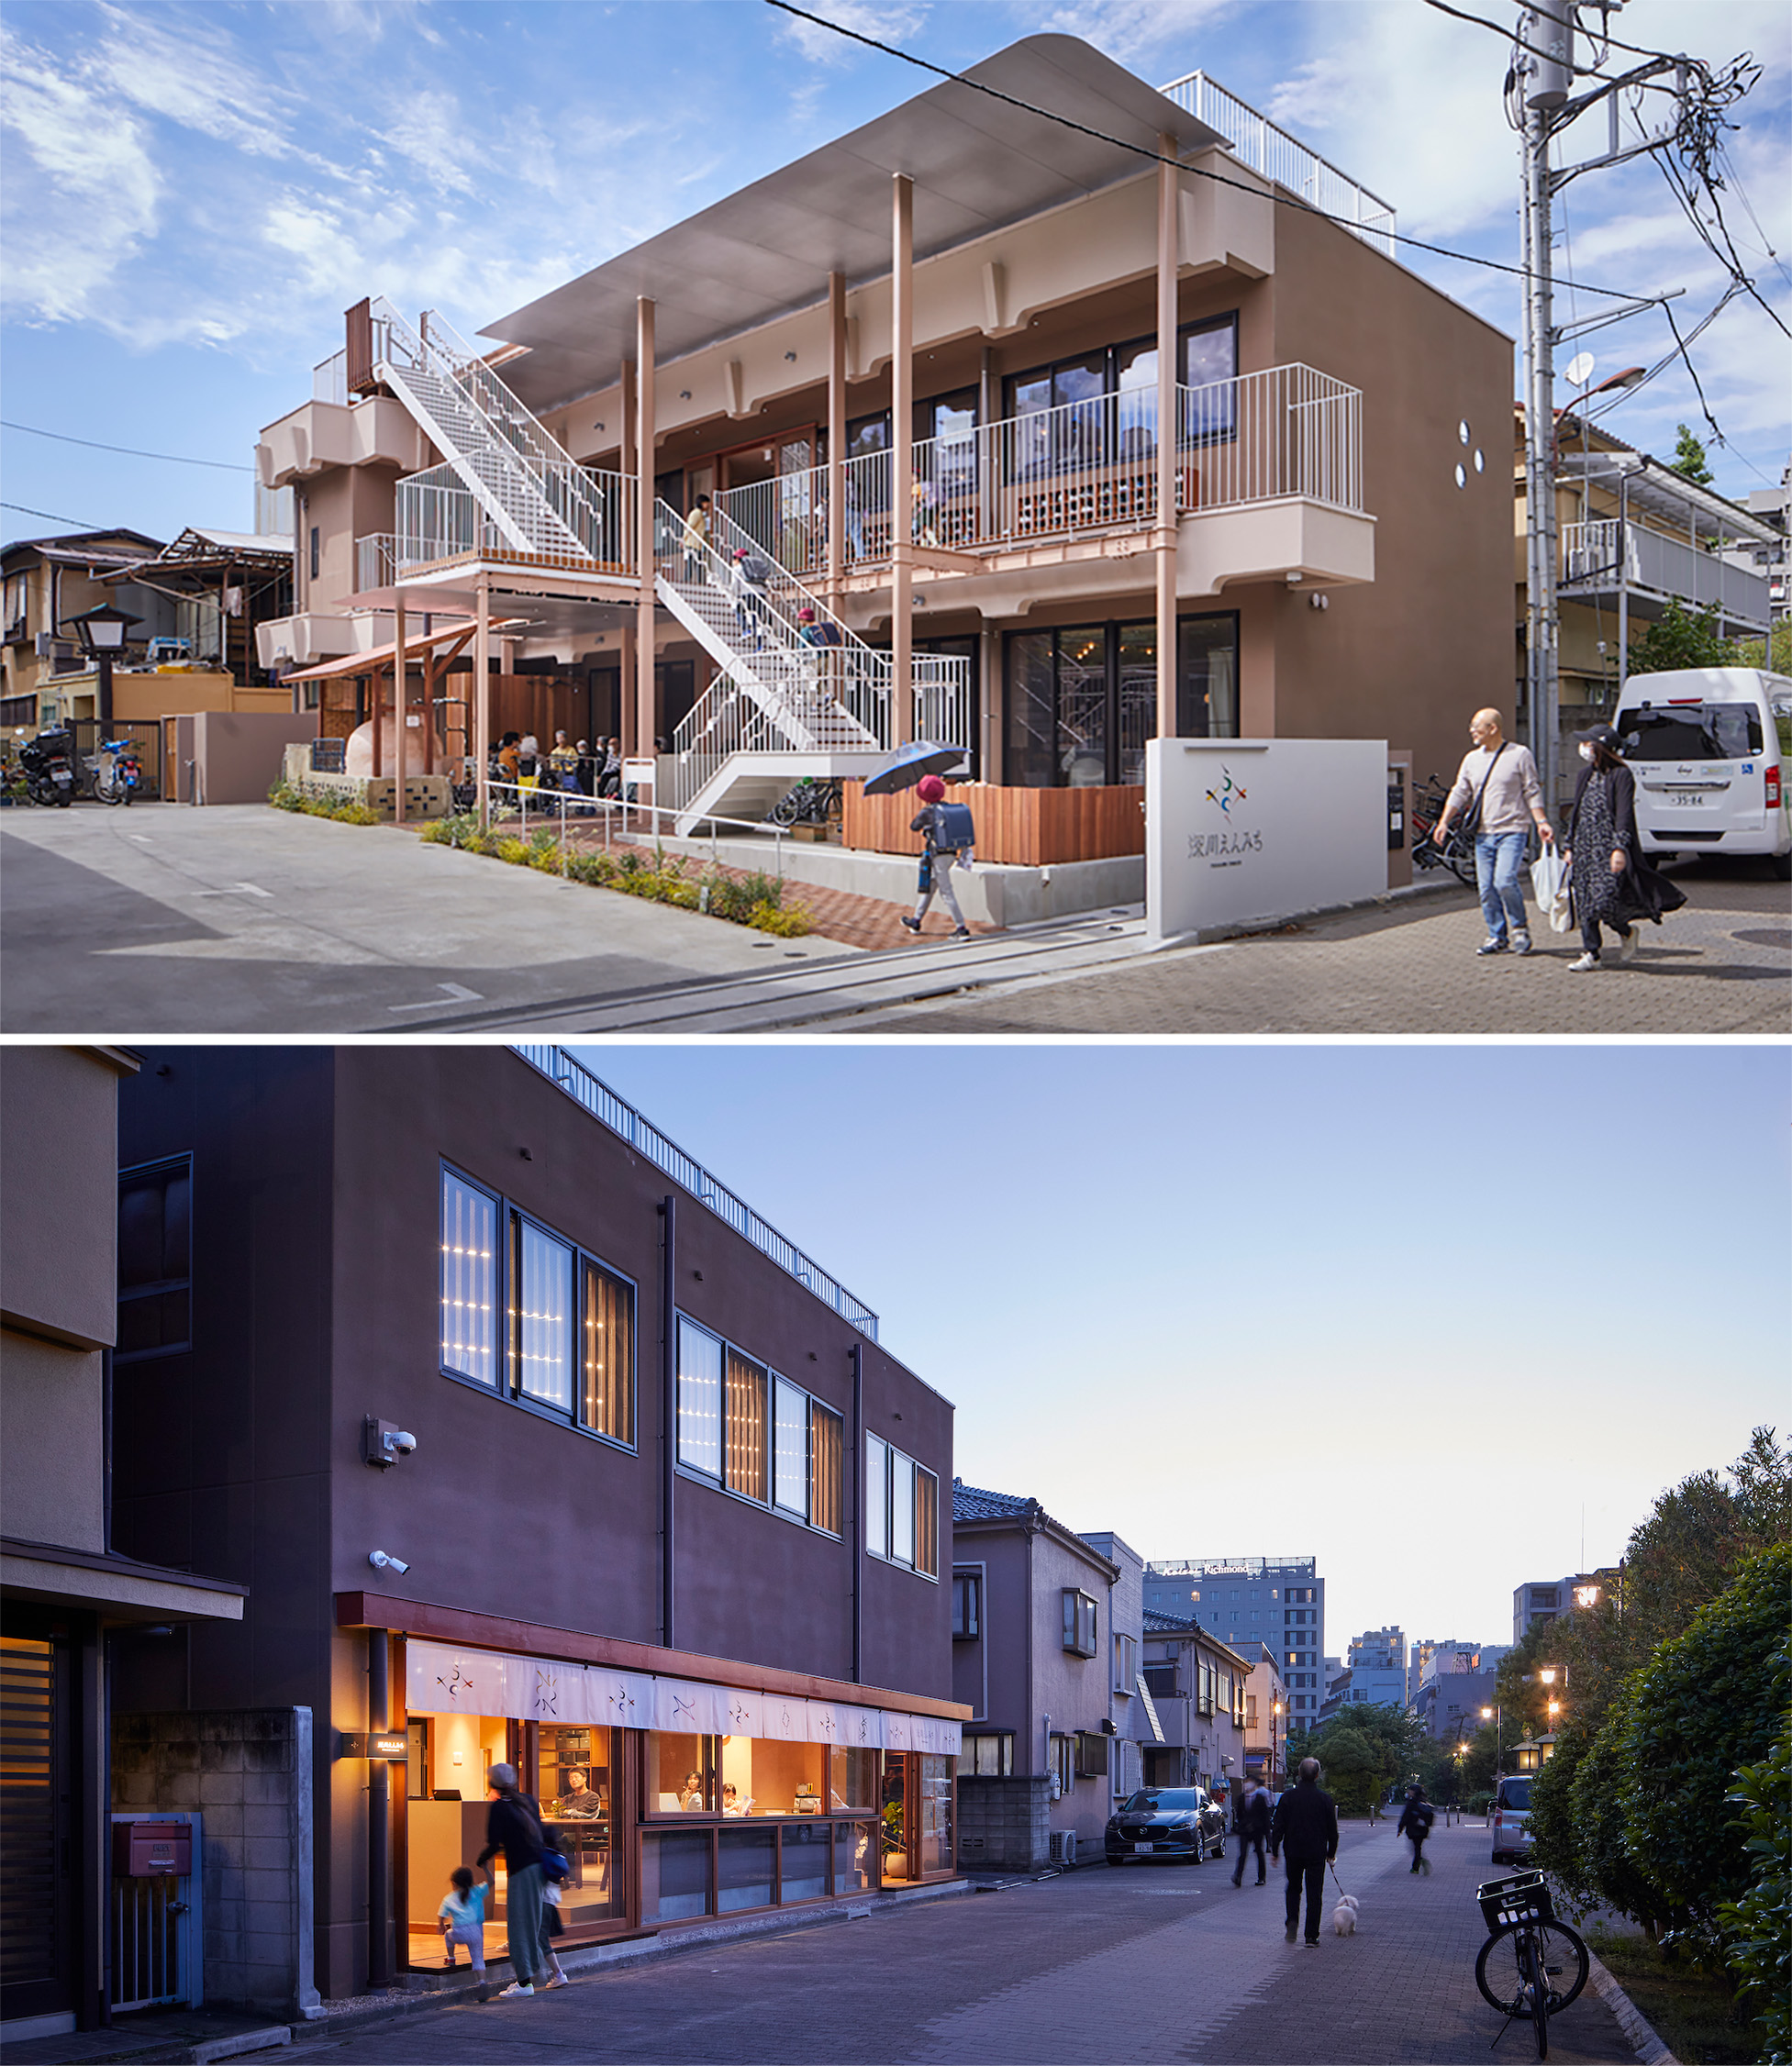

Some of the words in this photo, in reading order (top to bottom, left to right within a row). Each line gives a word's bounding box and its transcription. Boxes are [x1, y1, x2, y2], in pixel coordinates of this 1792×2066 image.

[1187, 829, 1263, 858] 深川えんみち
[1203, 1562, 1250, 1575] Richmond
